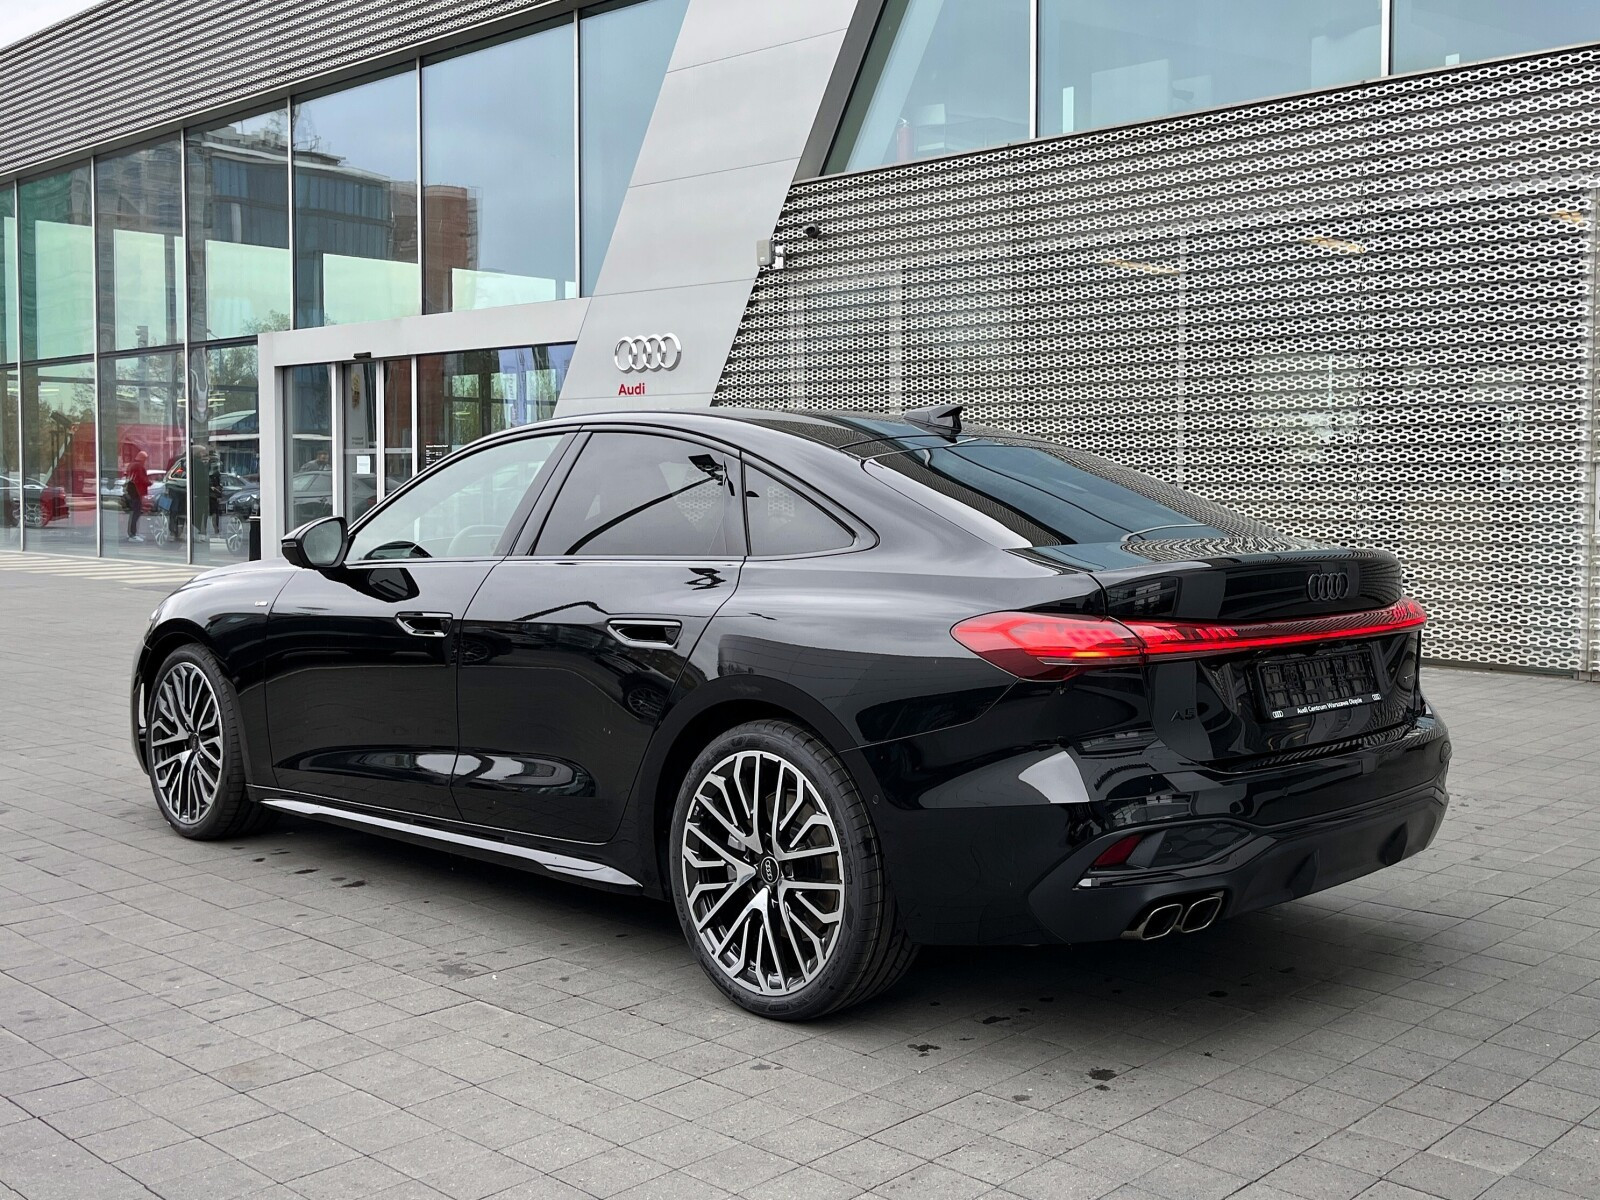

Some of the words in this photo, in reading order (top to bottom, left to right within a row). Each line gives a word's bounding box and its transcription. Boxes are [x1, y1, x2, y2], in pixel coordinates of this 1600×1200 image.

[618, 383, 645, 396] Audi
[1308, 704, 1327, 712] Centrum
[1327, 700, 1349, 709] Warszawa
[1170, 708, 1196, 721] A5
